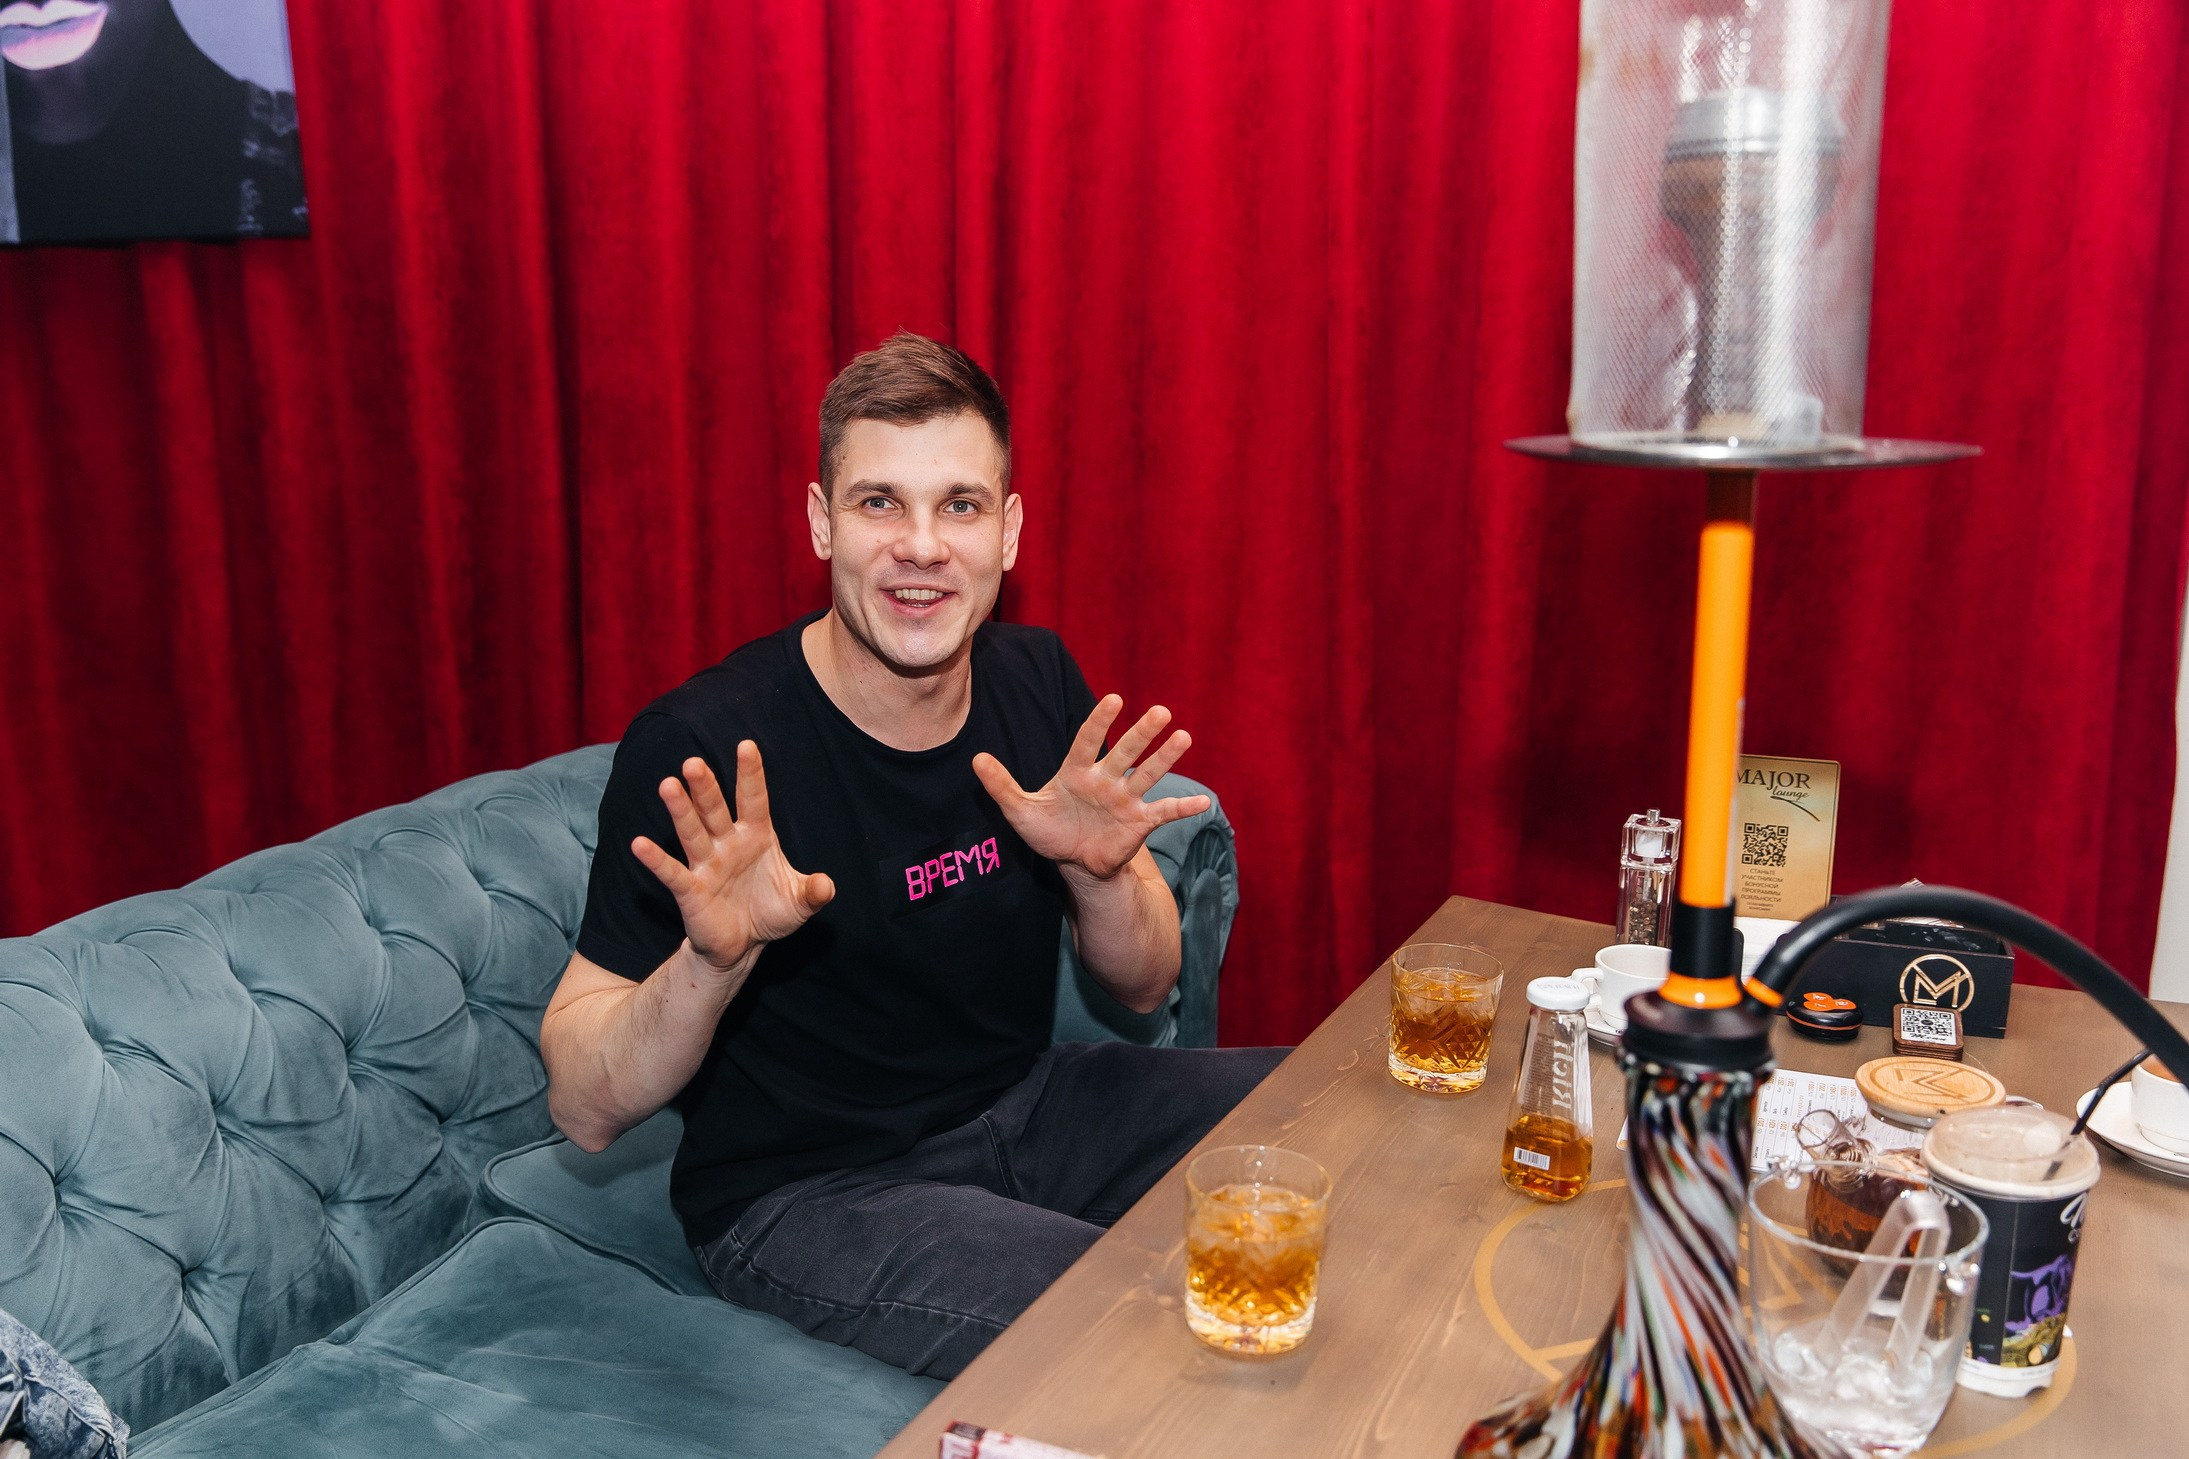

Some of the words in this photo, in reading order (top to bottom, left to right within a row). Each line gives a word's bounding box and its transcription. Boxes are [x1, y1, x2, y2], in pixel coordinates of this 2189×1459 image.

[1737, 768, 1811, 791] MAJOR
[1772, 785, 1809, 802] lounge
[905, 837, 1000, 901] ВРЕМЯ
[1741, 874, 1784, 883] УЧАСТНИКОМ
[1745, 880, 1779, 889] БОНУСНОЙ
[1741, 887, 1782, 896] ПРОГРАММЫ
[1740, 893, 1782, 903] ЛОЯЛЬНОСТИ
